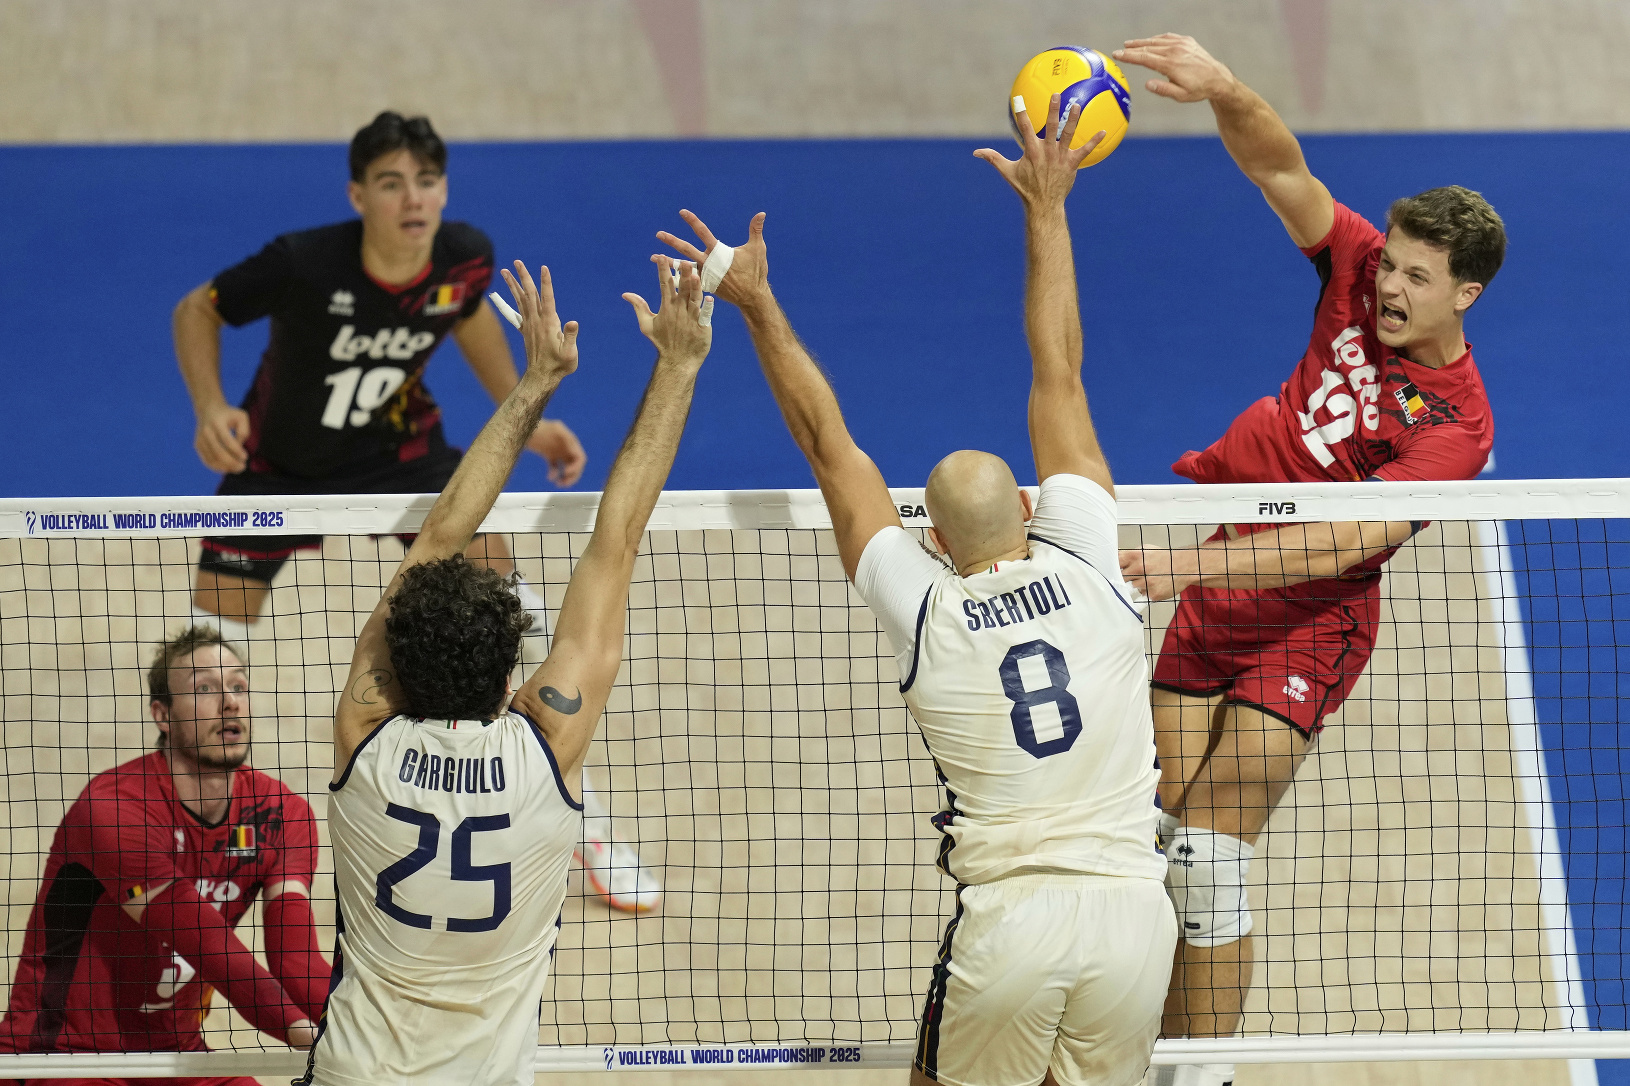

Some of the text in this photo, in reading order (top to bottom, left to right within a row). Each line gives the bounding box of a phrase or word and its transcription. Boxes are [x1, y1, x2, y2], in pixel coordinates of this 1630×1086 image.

[321, 366, 407, 430] 19
[1297, 367, 1357, 469] 12
[40, 511, 284, 530] VOLLEYBALL WORLD CHAMPIONSHIP 2025
[1258, 502, 1296, 515] FIVB
[962, 573, 1072, 632] SBERTOLI
[998, 638, 1083, 759] 8
[399, 748, 506, 793] GARGIULO
[375, 802, 511, 932] 25
[618, 1047, 861, 1065] VOLLEYBALL WORLD CHAMPIONSHIP 2025
